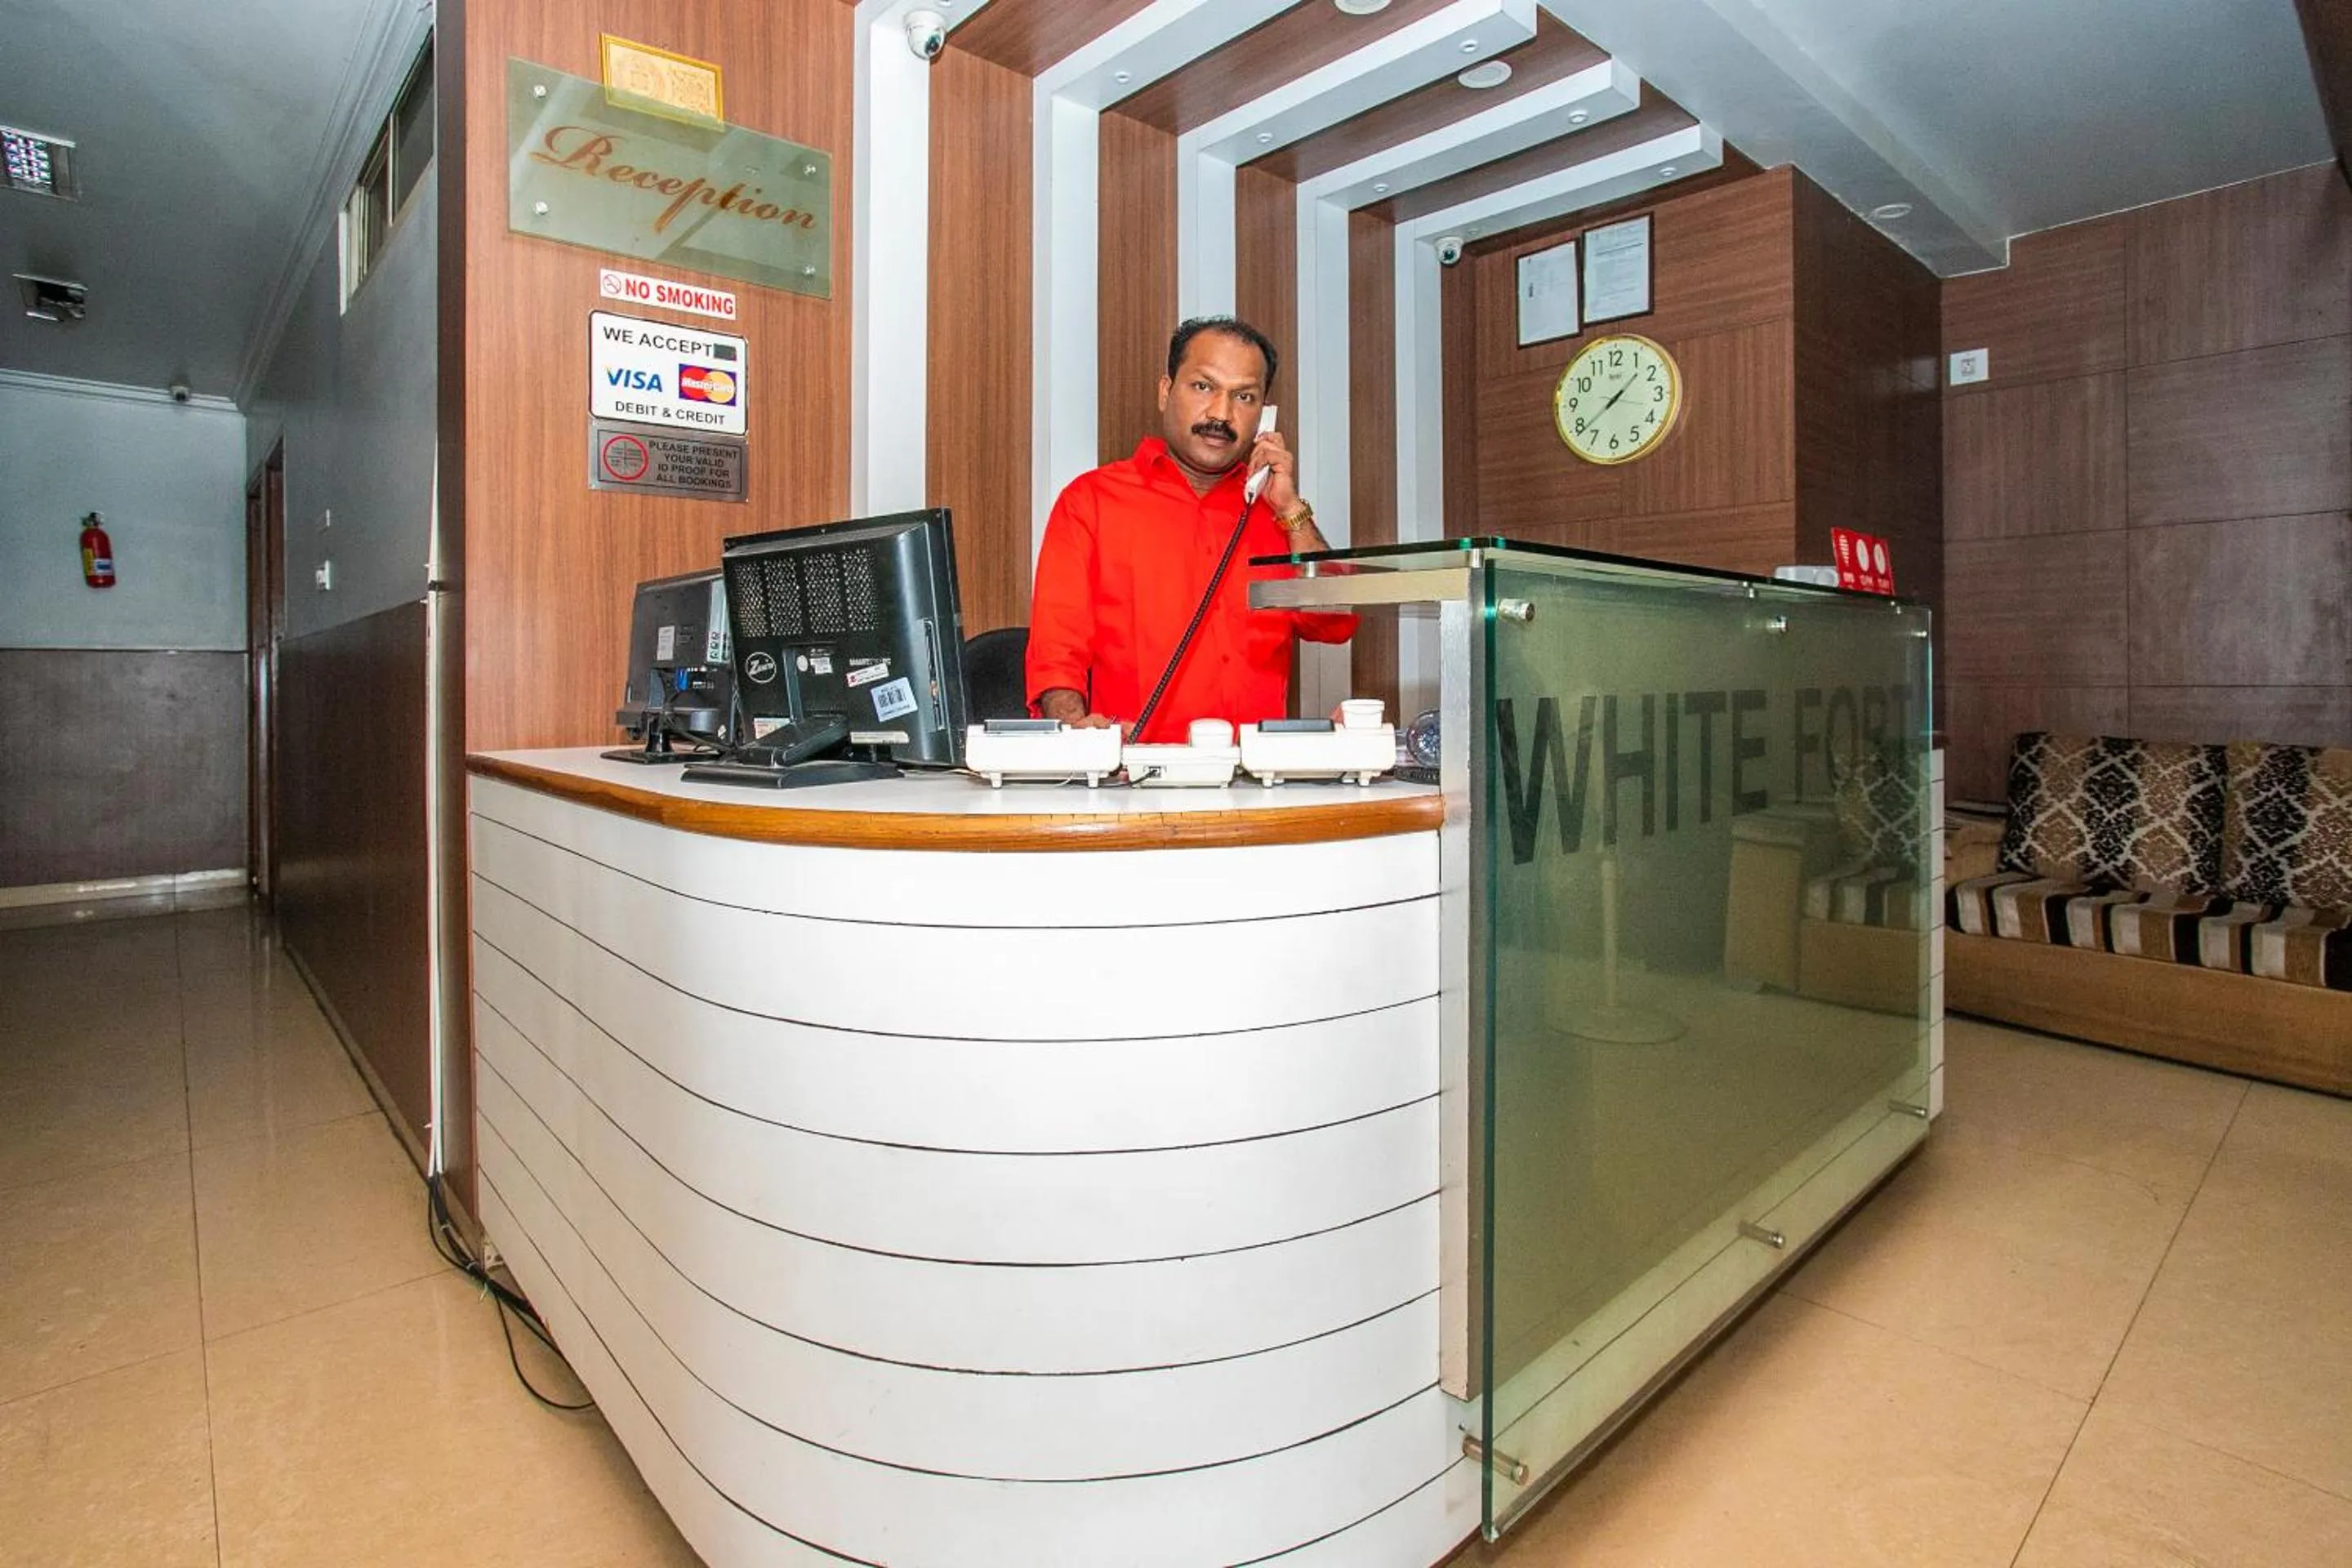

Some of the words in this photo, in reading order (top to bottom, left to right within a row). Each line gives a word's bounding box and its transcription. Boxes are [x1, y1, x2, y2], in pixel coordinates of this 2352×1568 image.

[528, 126, 817, 235] Reception
[626, 278, 650, 299] NO
[657, 285, 733, 314] SMOKING
[604, 326, 634, 344] WE
[639, 333, 712, 357] ACCEPT
[1609, 350, 1623, 367] 12
[1633, 353, 1638, 368] 1
[1592, 360, 1603, 376] 11
[1646, 365, 1656, 381] 2
[606, 368, 663, 393] VISA
[1578, 377, 1592, 393] 10
[1654, 385, 1664, 402] 3
[616, 401, 657, 416] DEBIT
[662, 408, 671, 418] &
[676, 409, 725, 425] CREDIT
[1569, 398, 1578, 412] 9
[1645, 409, 1655, 424] 4
[1575, 417, 1585, 434] 8
[1590, 430, 1599, 445] 7
[1610, 434, 1619, 449] 6
[1629, 426, 1639, 443] 5
[649, 440, 689, 453] PLEASE
[693, 446, 737, 458] PRESENT
[665, 453, 693, 464] YOUR
[696, 457, 724, 467] VALID
[658, 464, 668, 472] ID
[672, 465, 706, 474] PROOF
[710, 469, 729, 478] FOR
[657, 474, 675, 483] ALL
[679, 476, 732, 488] BOOKINGS
[1496, 689, 1767, 866] WHITE
[1794, 684, 1913, 804] FORT
